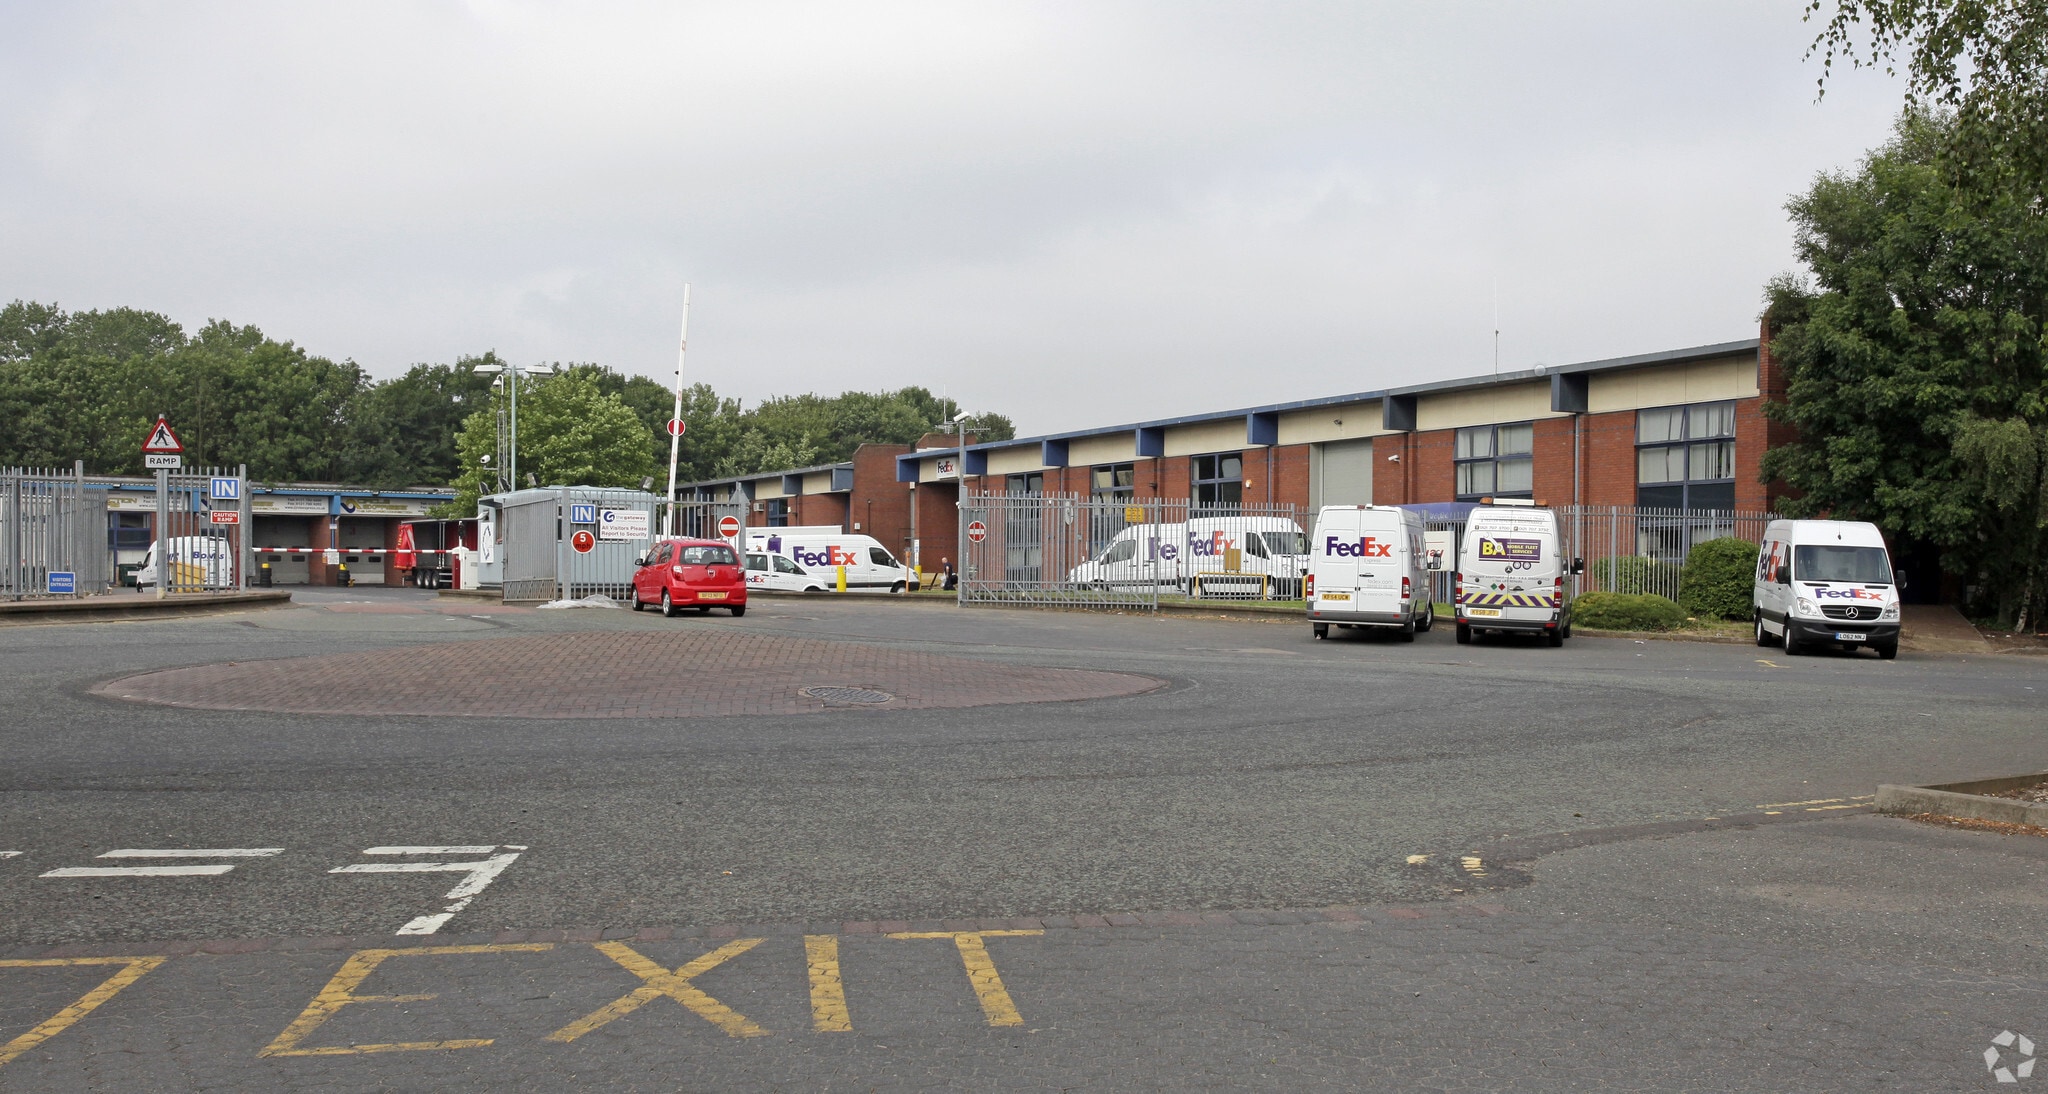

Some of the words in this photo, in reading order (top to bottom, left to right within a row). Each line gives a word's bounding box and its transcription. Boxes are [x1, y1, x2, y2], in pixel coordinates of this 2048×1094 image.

[149, 457, 177, 465] RAMP
[937, 460, 954, 473] FedEx
[215, 480, 236, 496] IN
[575, 506, 592, 521] IN
[579, 533, 587, 543] 5
[1326, 536, 1392, 557] FedEx
[1482, 541, 1506, 555] BA
[793, 545, 857, 566] FedEx
[1757, 539, 1782, 582] FedEx
[746, 575, 765, 583] edEx
[1814, 588, 1884, 602] FedEx
[258, 927, 1045, 1058] EXIT
